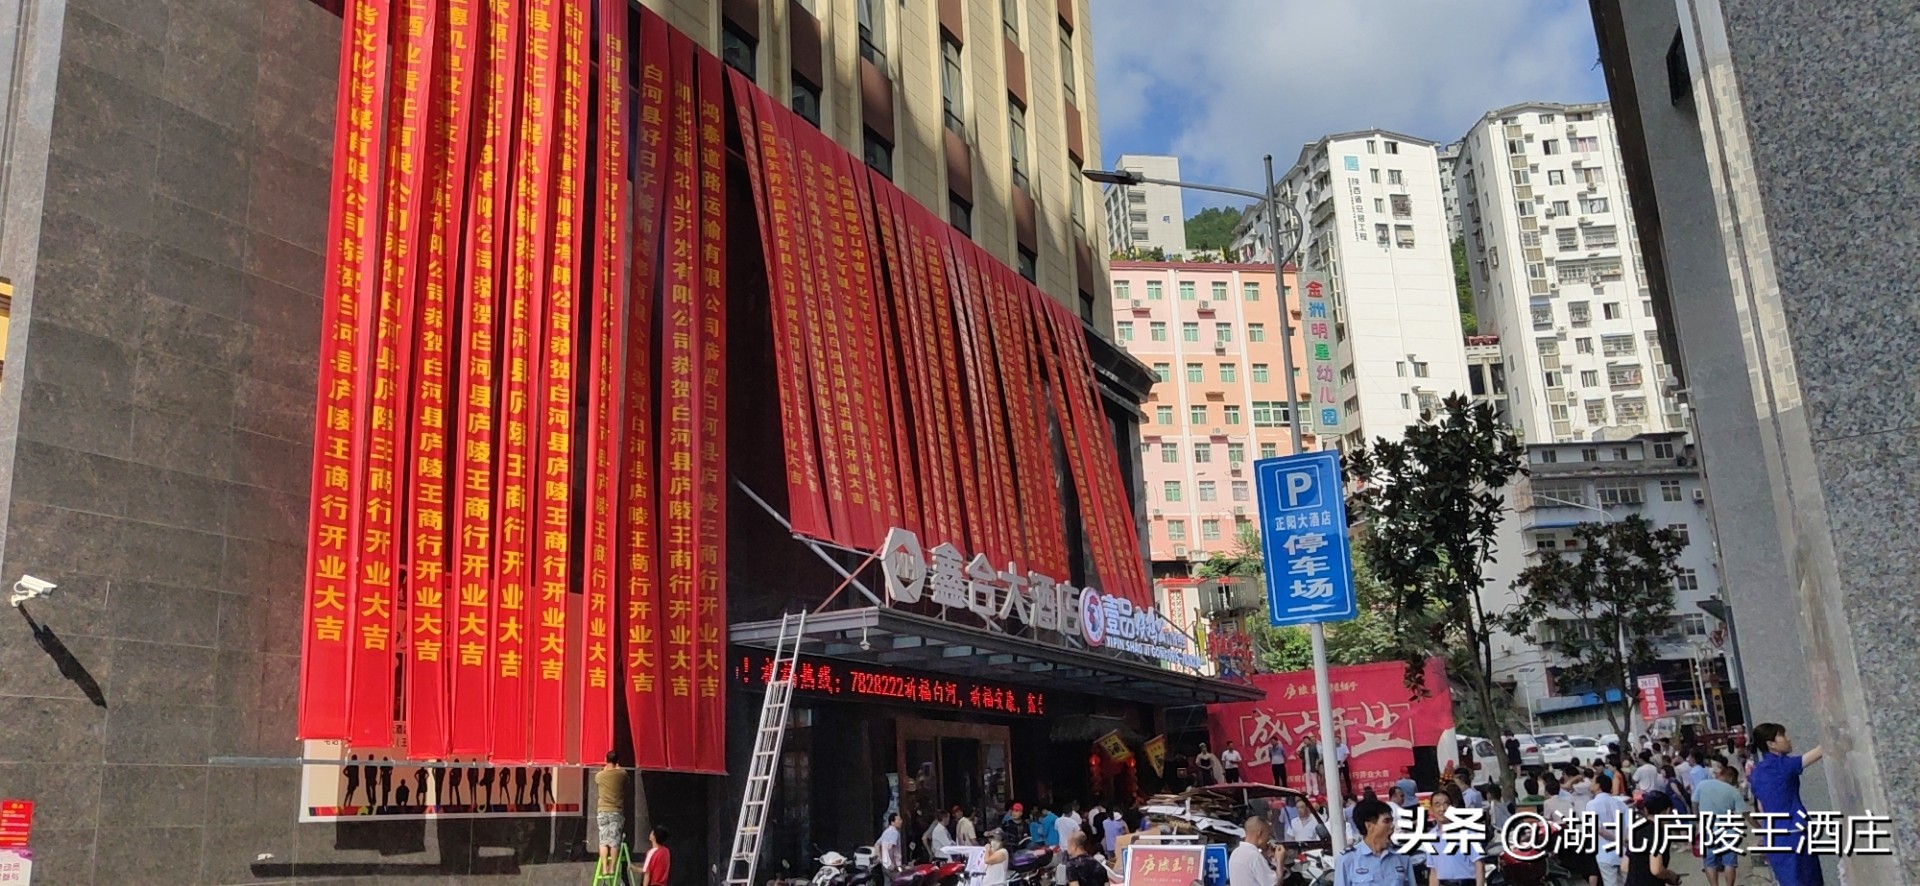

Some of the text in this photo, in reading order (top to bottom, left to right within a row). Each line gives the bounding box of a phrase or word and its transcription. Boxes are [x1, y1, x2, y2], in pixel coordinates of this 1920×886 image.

[1306, 280, 1338, 425] 金洲明星幼儿园
[1286, 472, 1312, 507] P
[1275, 510, 1331, 532] 正阳大酒店
[931, 542, 1080, 637] 鑫合大酒店
[1283, 533, 1334, 599] 停车场
[1207, 856, 1220, 884] 车
